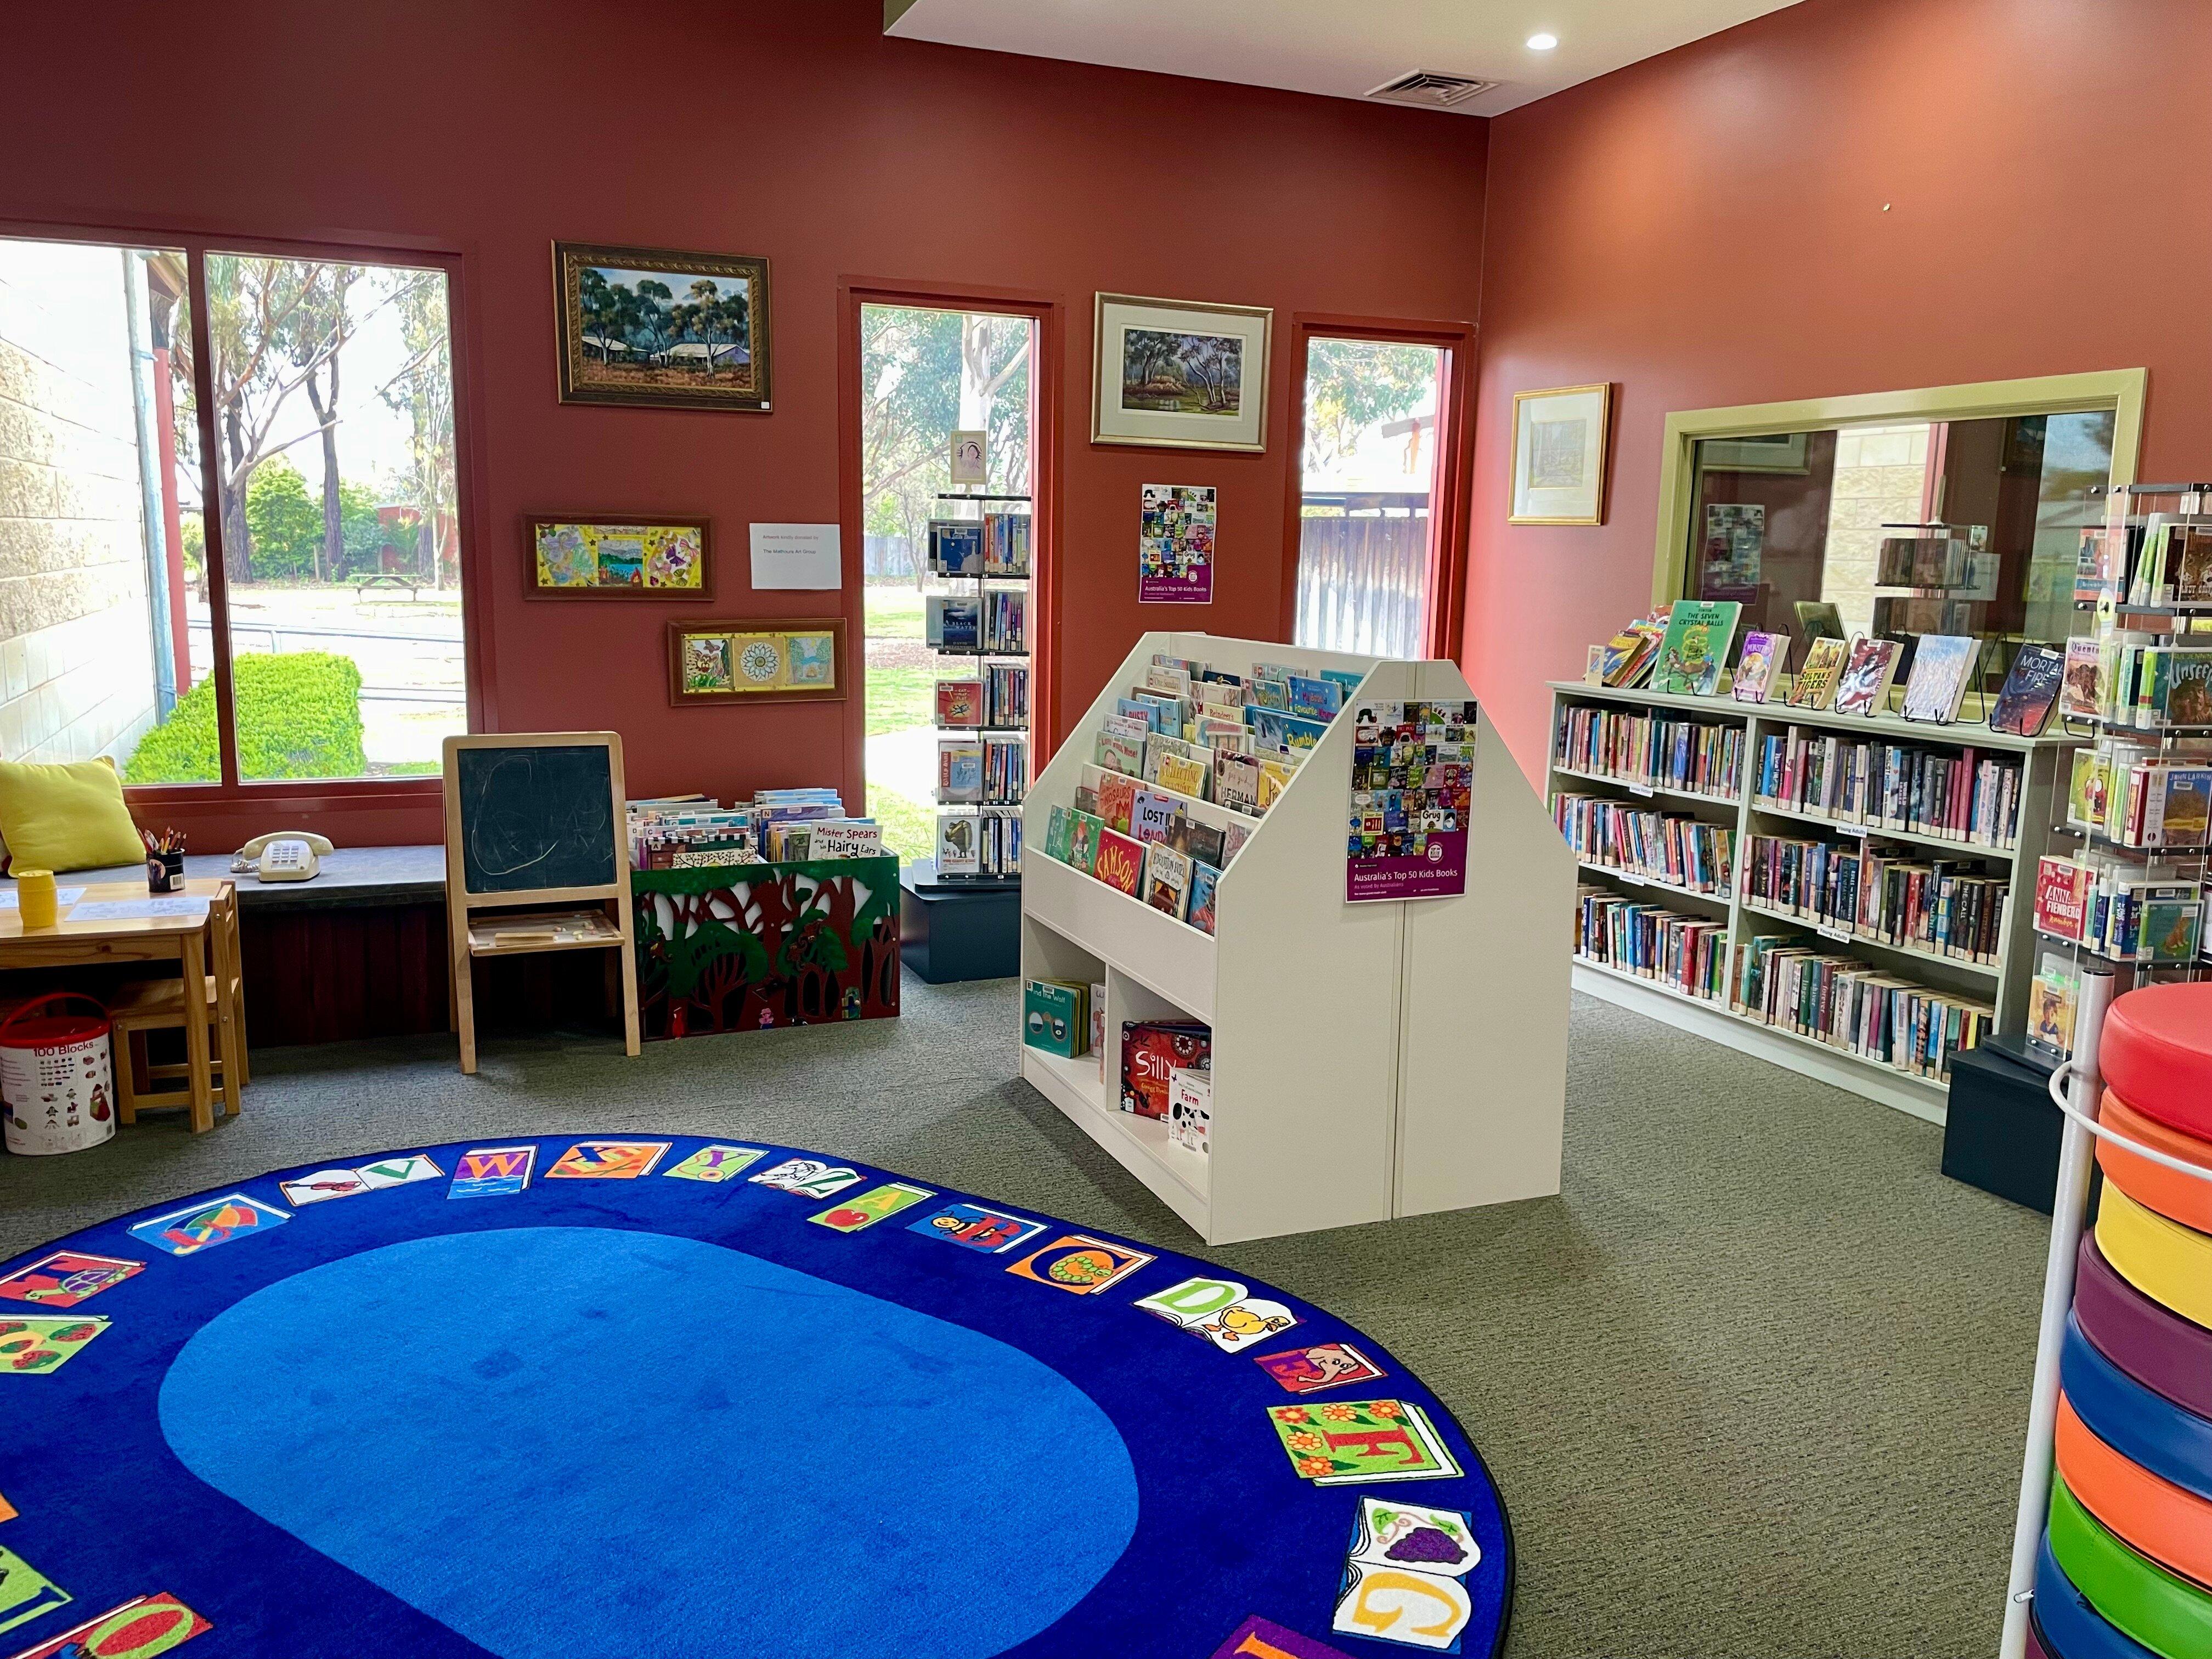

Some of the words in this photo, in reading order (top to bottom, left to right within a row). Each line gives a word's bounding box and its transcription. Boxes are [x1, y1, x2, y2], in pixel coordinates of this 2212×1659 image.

[2021, 655, 2063, 675] MORTAL
[1796, 680, 1827, 691] TIGERS
[2025, 670, 2048, 684] FIRE
[1163, 768, 1198, 782] COLLECTING
[1100, 787, 1131, 809] DINOSAURS
[1221, 787, 1256, 806] HERMAN
[1143, 807, 1164, 825] LOST
[1423, 810, 1441, 822] Grug
[817, 827, 844, 838] Mister
[847, 829, 877, 840] Spears
[1138, 824, 1167, 844] LOND
[827, 839, 859, 858] Hairy
[861, 844, 876, 855] Ears
[1097, 845, 1134, 893] SAMSON
[1354, 871, 1392, 882] Australia's
[1393, 871, 1407, 881] Top
[1419, 870, 1434, 878] Kids
[1436, 868, 1458, 877] Books
[2045, 885, 2071, 904] ANNA
[2046, 900, 2080, 919] FIENBERG
[33, 1047, 55, 1057] 100
[59, 1041, 94, 1055] Blocks
[1136, 1051, 1176, 1080] Silly
[1181, 1089, 1199, 1106] Farm
[463, 1153, 529, 1178] W
[700, 1151, 748, 1166] Y
[365, 1160, 417, 1179] V
[798, 1167, 857, 1194] Z
[857, 1191, 902, 1211] A
[950, 1215, 1023, 1246] B
[1030, 1246, 1133, 1285] C
[1154, 1281, 1238, 1313] D
[1321, 1425, 1424, 1466] F
[1352, 1573, 1462, 1638] G
